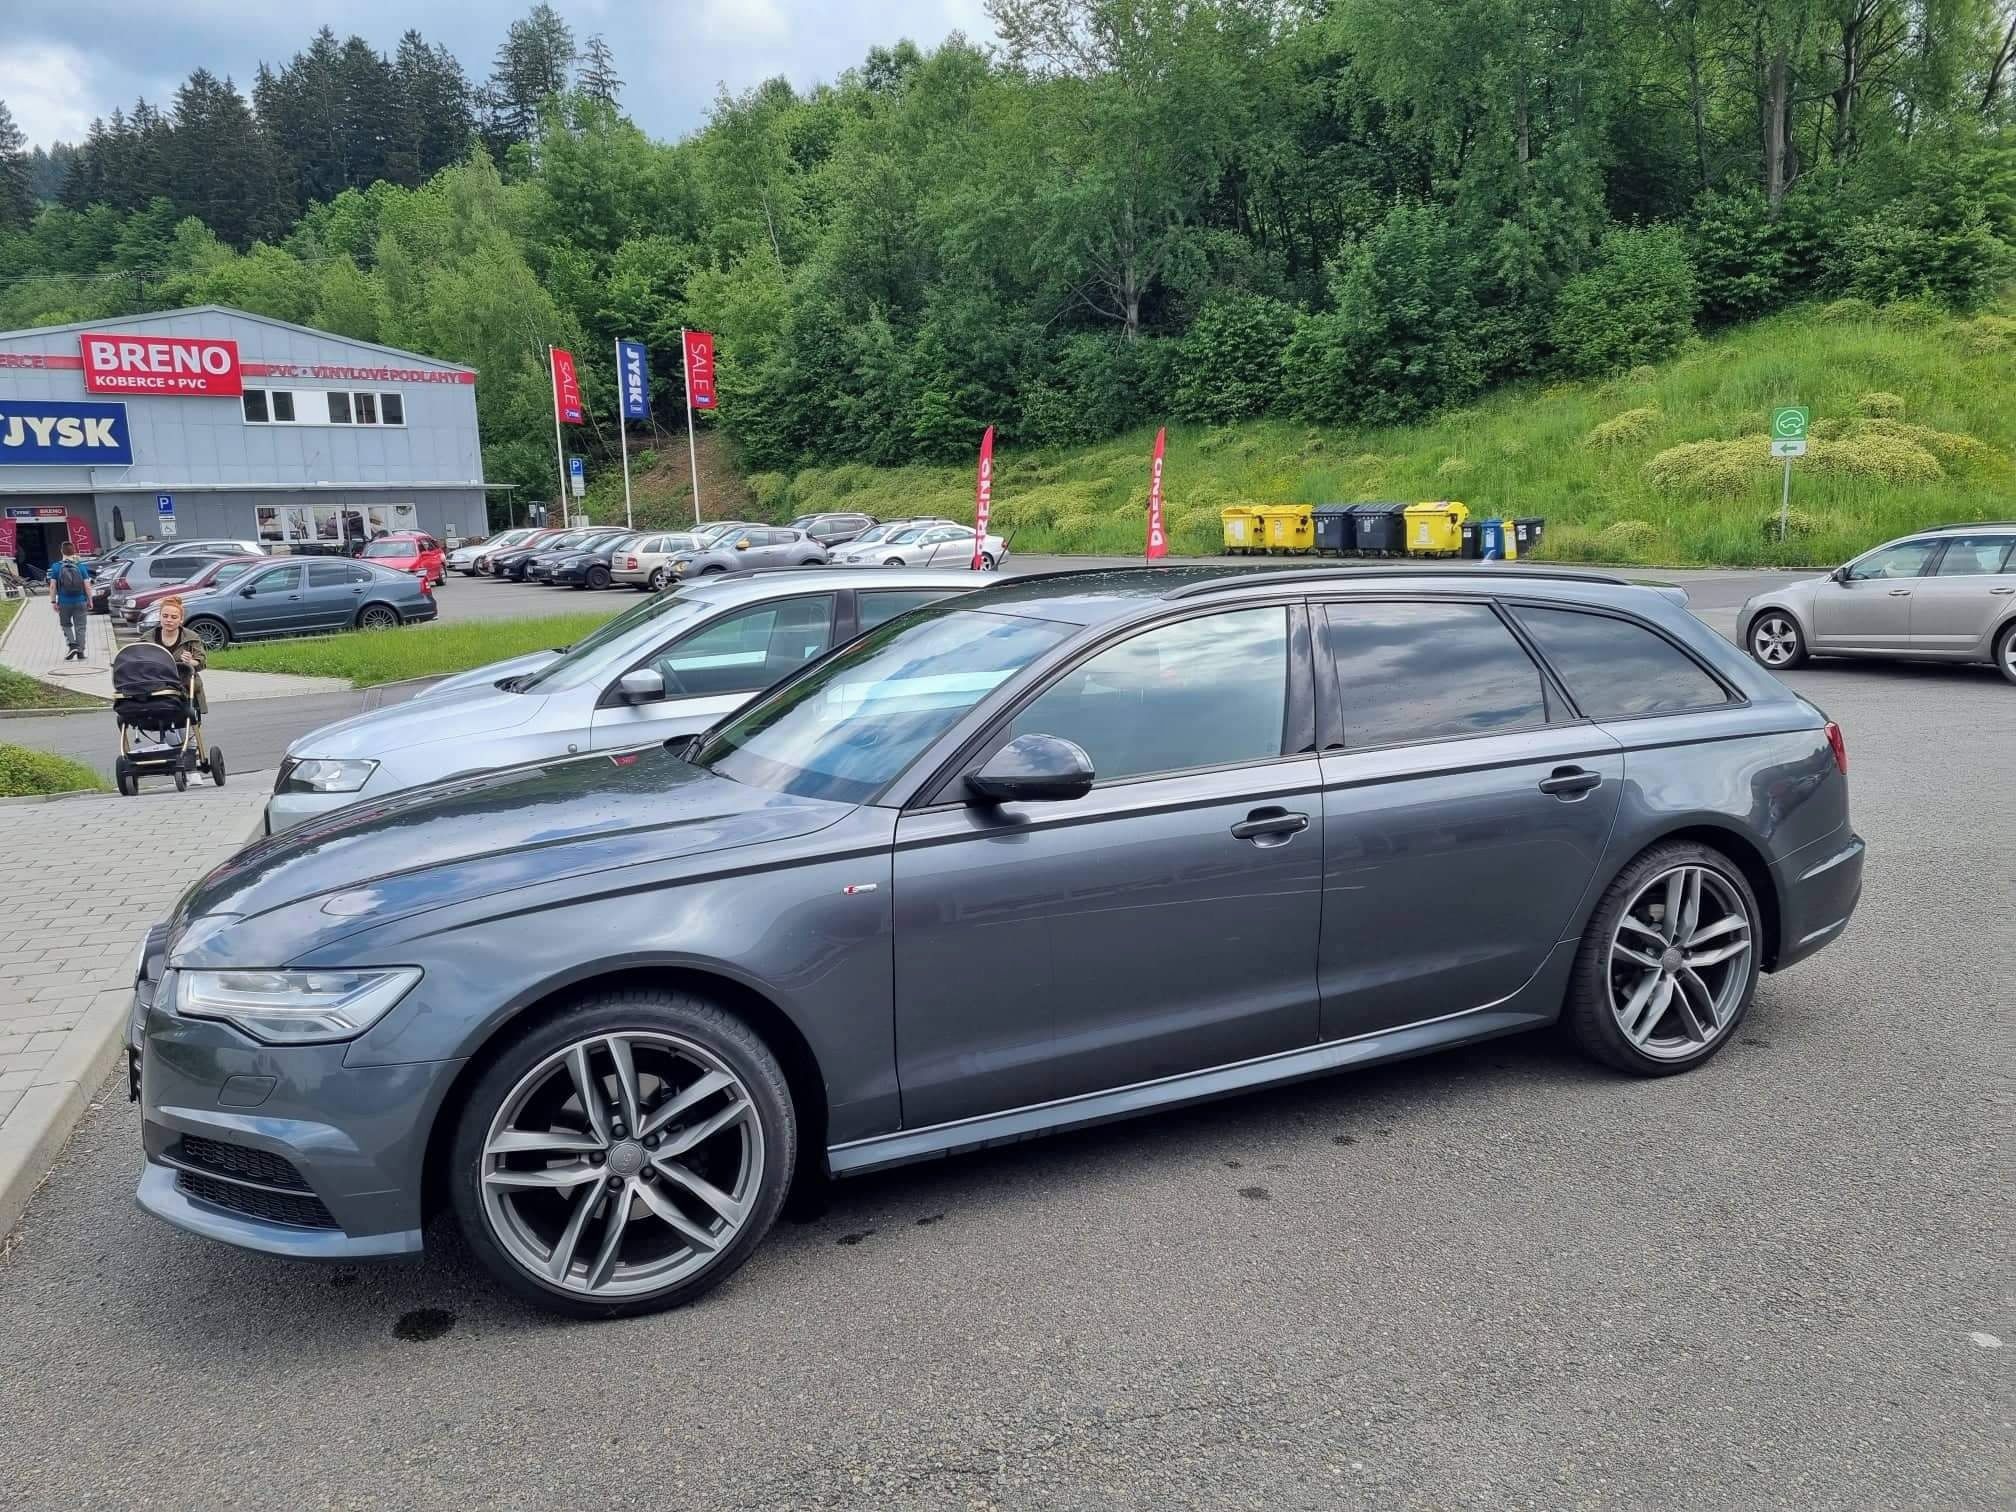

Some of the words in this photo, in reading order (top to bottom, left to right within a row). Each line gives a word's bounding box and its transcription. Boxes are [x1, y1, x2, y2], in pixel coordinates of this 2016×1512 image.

[90, 341, 231, 375] BRENO
[692, 343, 709, 392] SALE
[95, 375, 166, 388] KOBERCE
[178, 379, 207, 388] PVC
[560, 361, 578, 405] SALE
[627, 347, 643, 403] JYSK
[3, 416, 120, 448] JYSK
[572, 460, 580, 471] P
[160, 497, 169, 509] P
